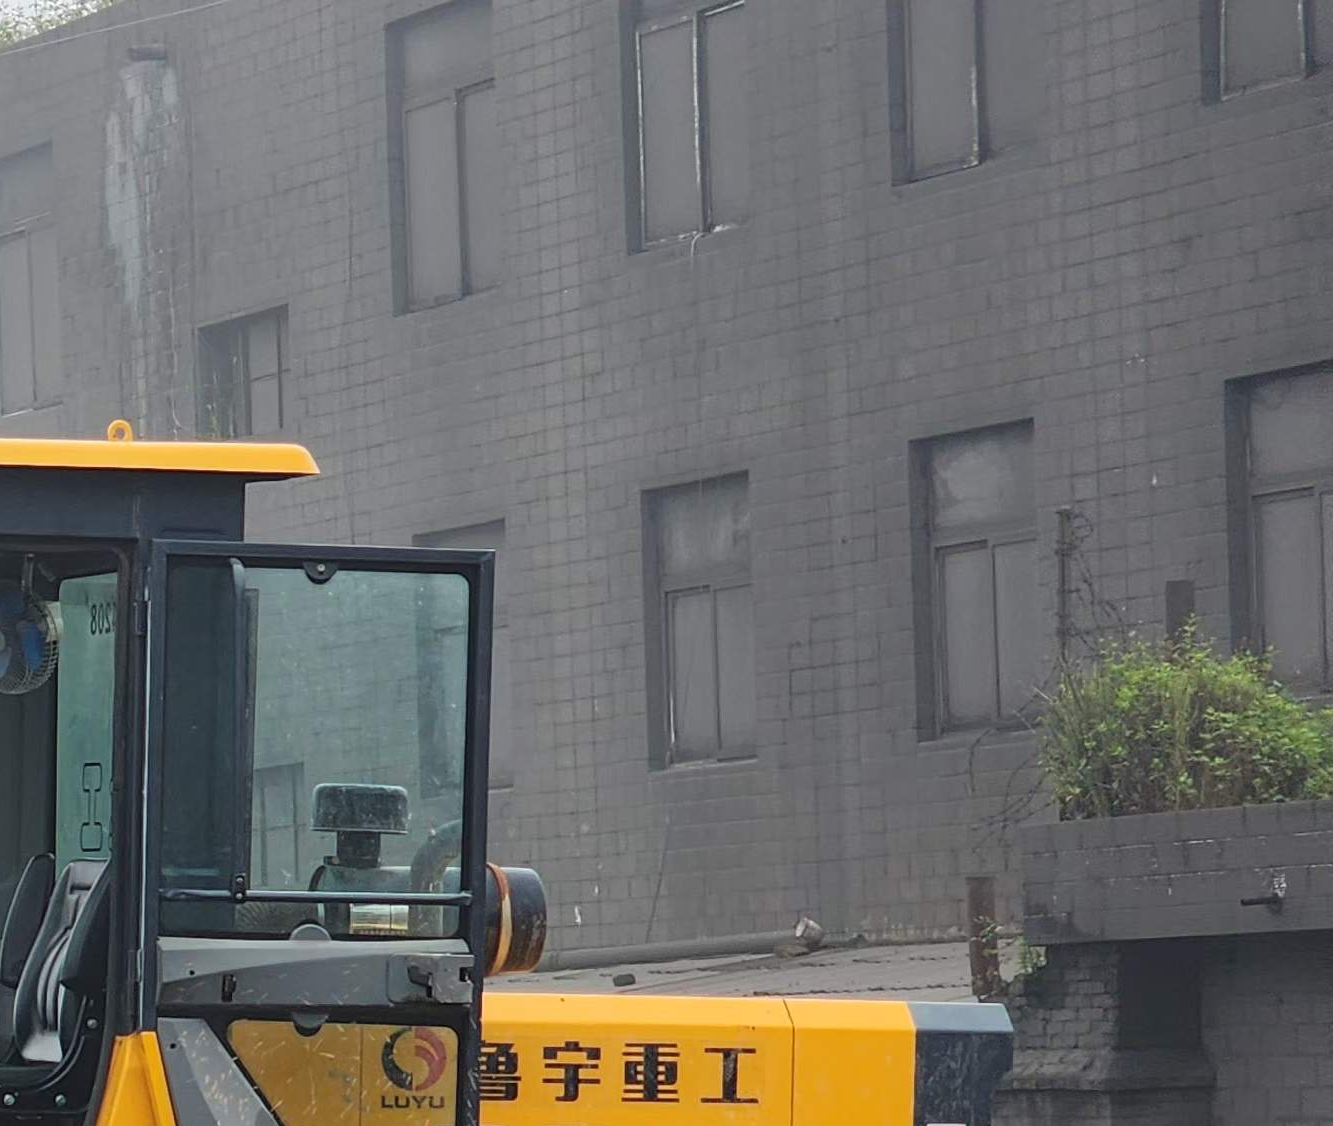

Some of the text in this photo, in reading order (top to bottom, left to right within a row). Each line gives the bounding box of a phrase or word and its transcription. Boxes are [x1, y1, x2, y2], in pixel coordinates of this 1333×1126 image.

[479, 1041, 759, 1104] 鲁宇重工
[380, 1095, 445, 1109] LUYU
